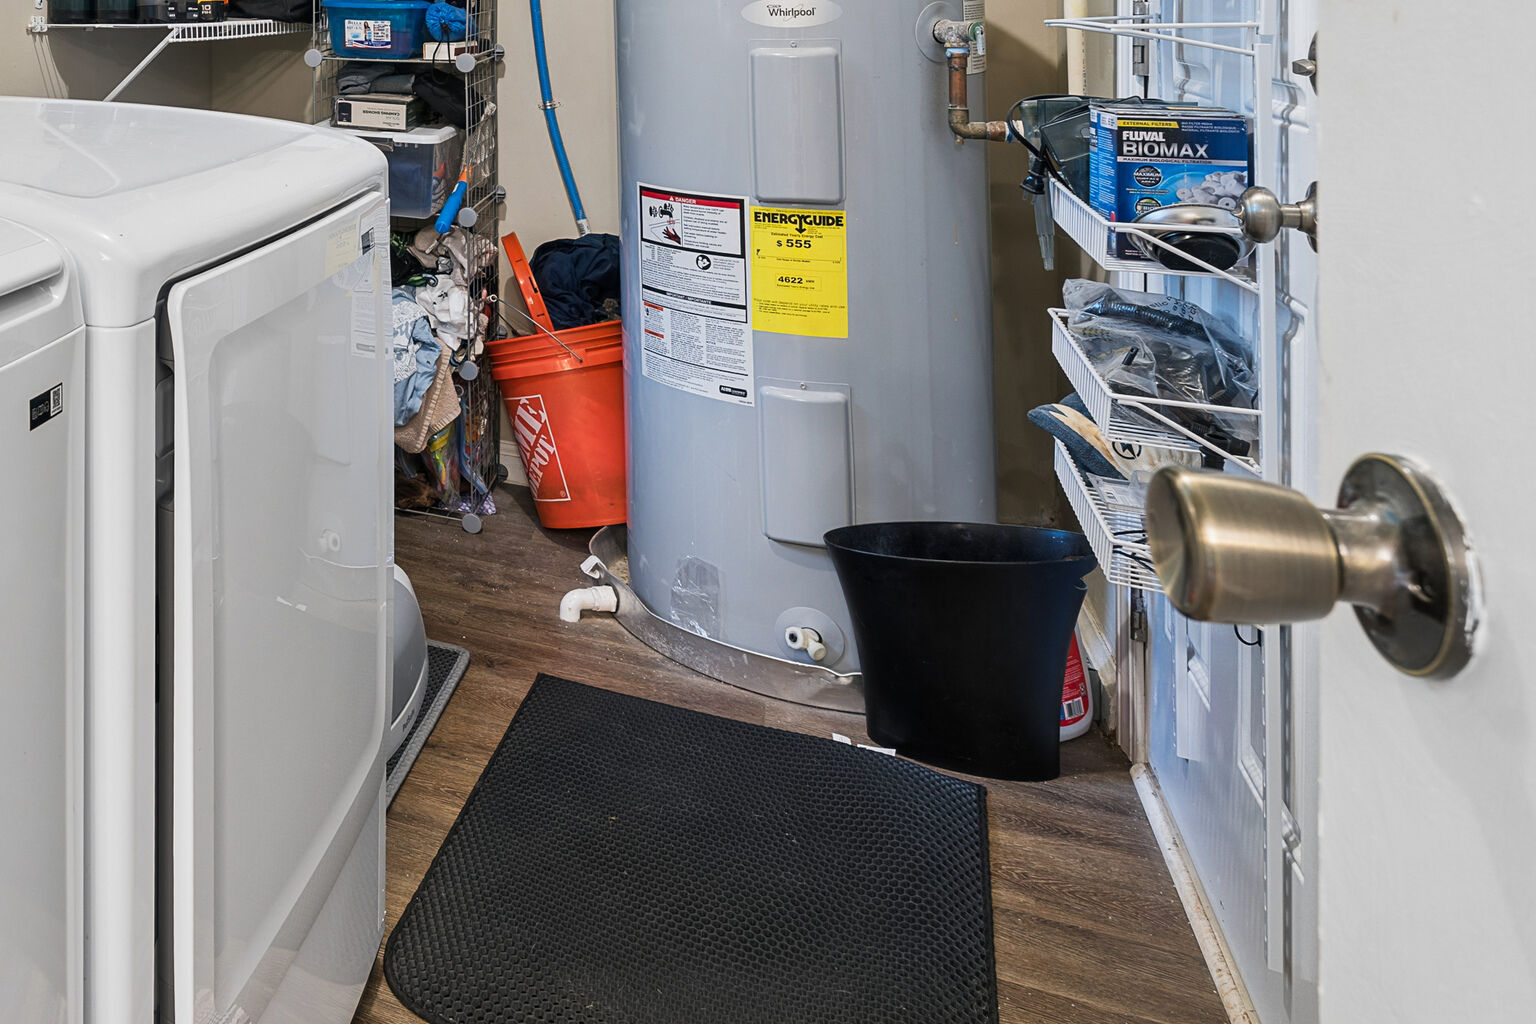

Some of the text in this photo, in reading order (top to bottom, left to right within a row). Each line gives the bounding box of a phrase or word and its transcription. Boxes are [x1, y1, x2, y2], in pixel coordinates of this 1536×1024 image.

[768, 8, 815, 19] Whirlpool
[1122, 130, 1166, 142] FLUVAL
[1122, 142, 1209, 159] BIOMAX
[675, 197, 697, 205] DANGER
[753, 211, 844, 227] ENERGYGUIDE
[776, 238, 812, 249] $ 555
[778, 276, 803, 285] 4622
